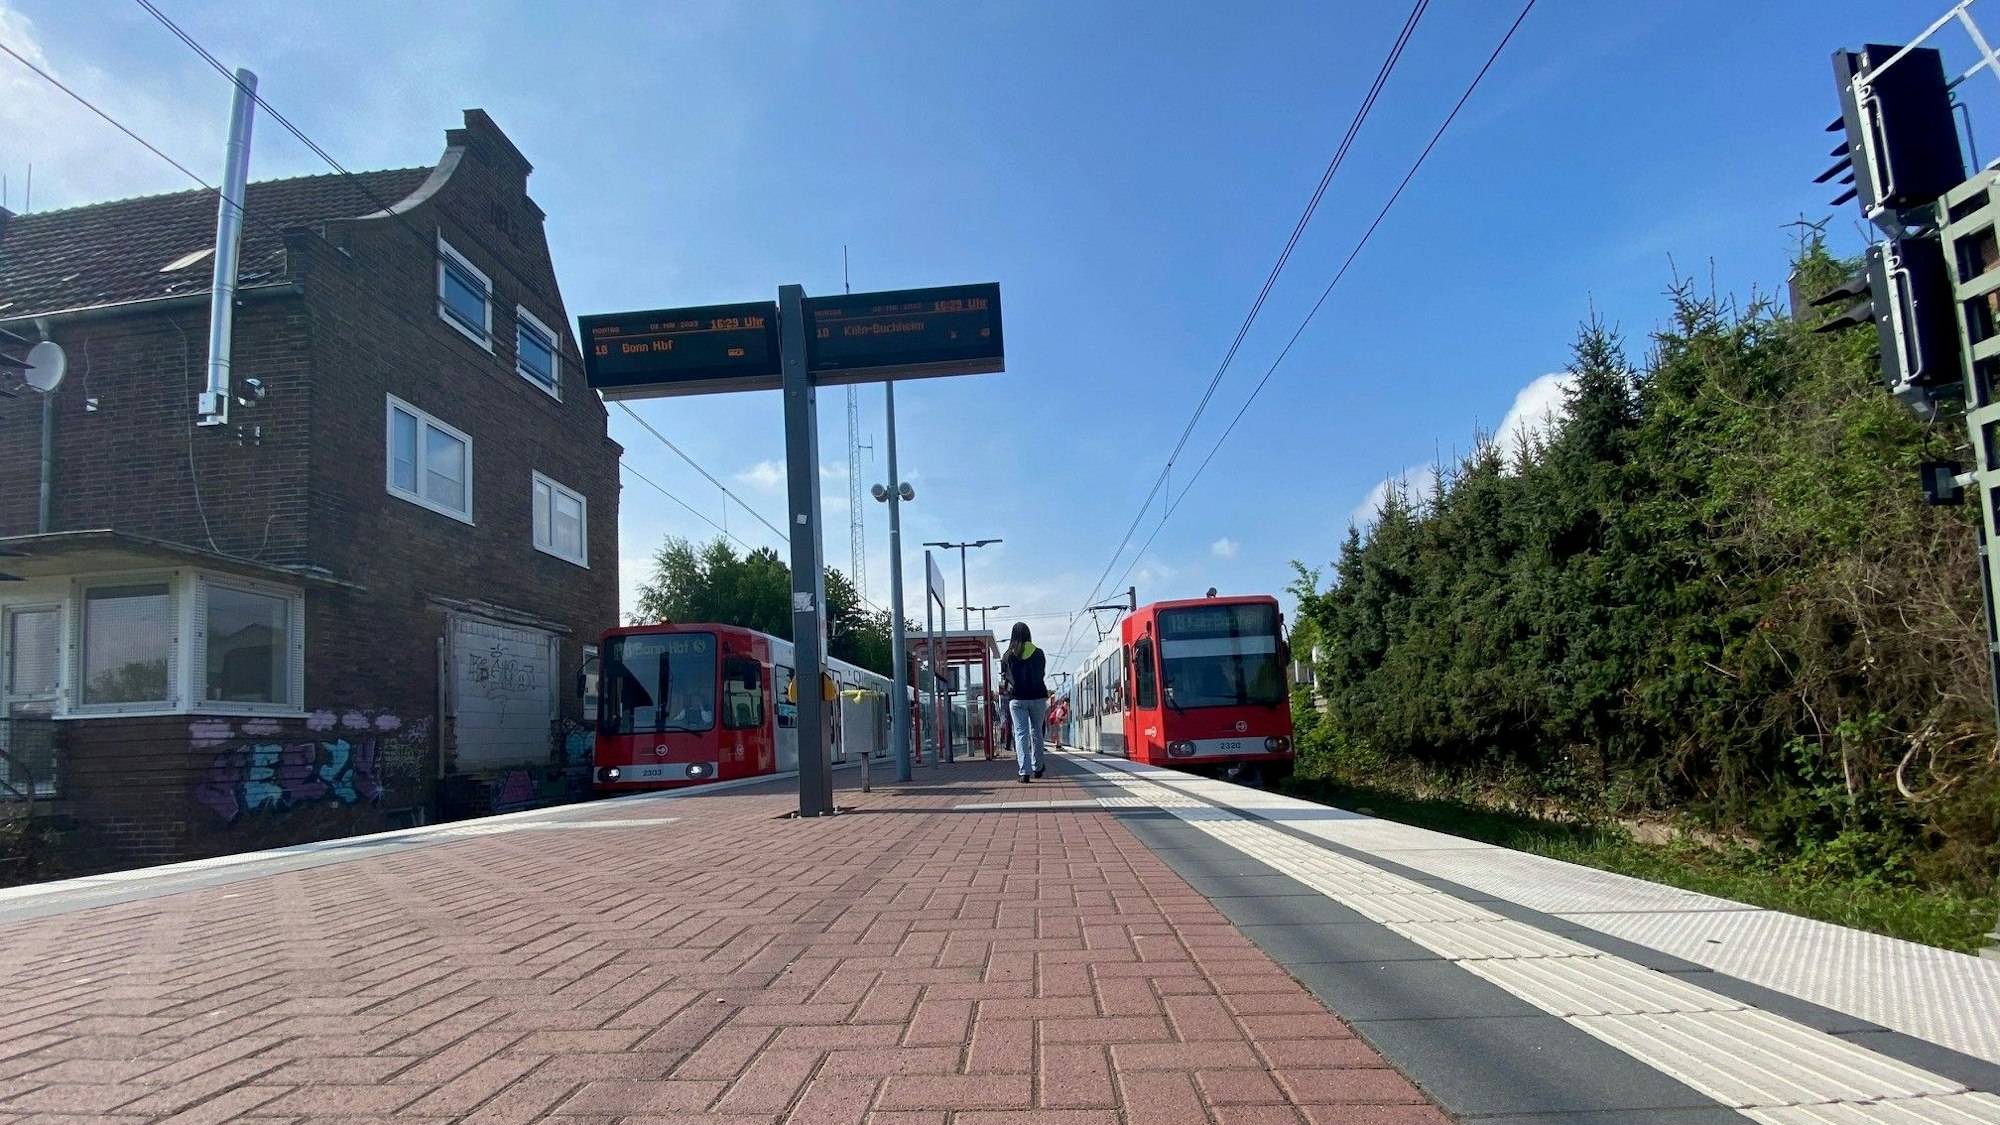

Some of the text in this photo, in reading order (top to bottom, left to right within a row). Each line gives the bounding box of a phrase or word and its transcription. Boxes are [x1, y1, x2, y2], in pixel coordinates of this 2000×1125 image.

[934, 299, 962, 312] 16:29
[968, 298, 987, 310] Uhr
[711, 318, 739, 329] 16:29
[744, 316, 765, 328] Uhr
[816, 321, 925, 339] 18 Köln-Buchheim
[594, 339, 674, 356] 18 Bonn Hbf
[669, 640, 689, 654] Hbf
[1219, 741, 1241, 750] 2320
[642, 769, 662, 777] 2303
